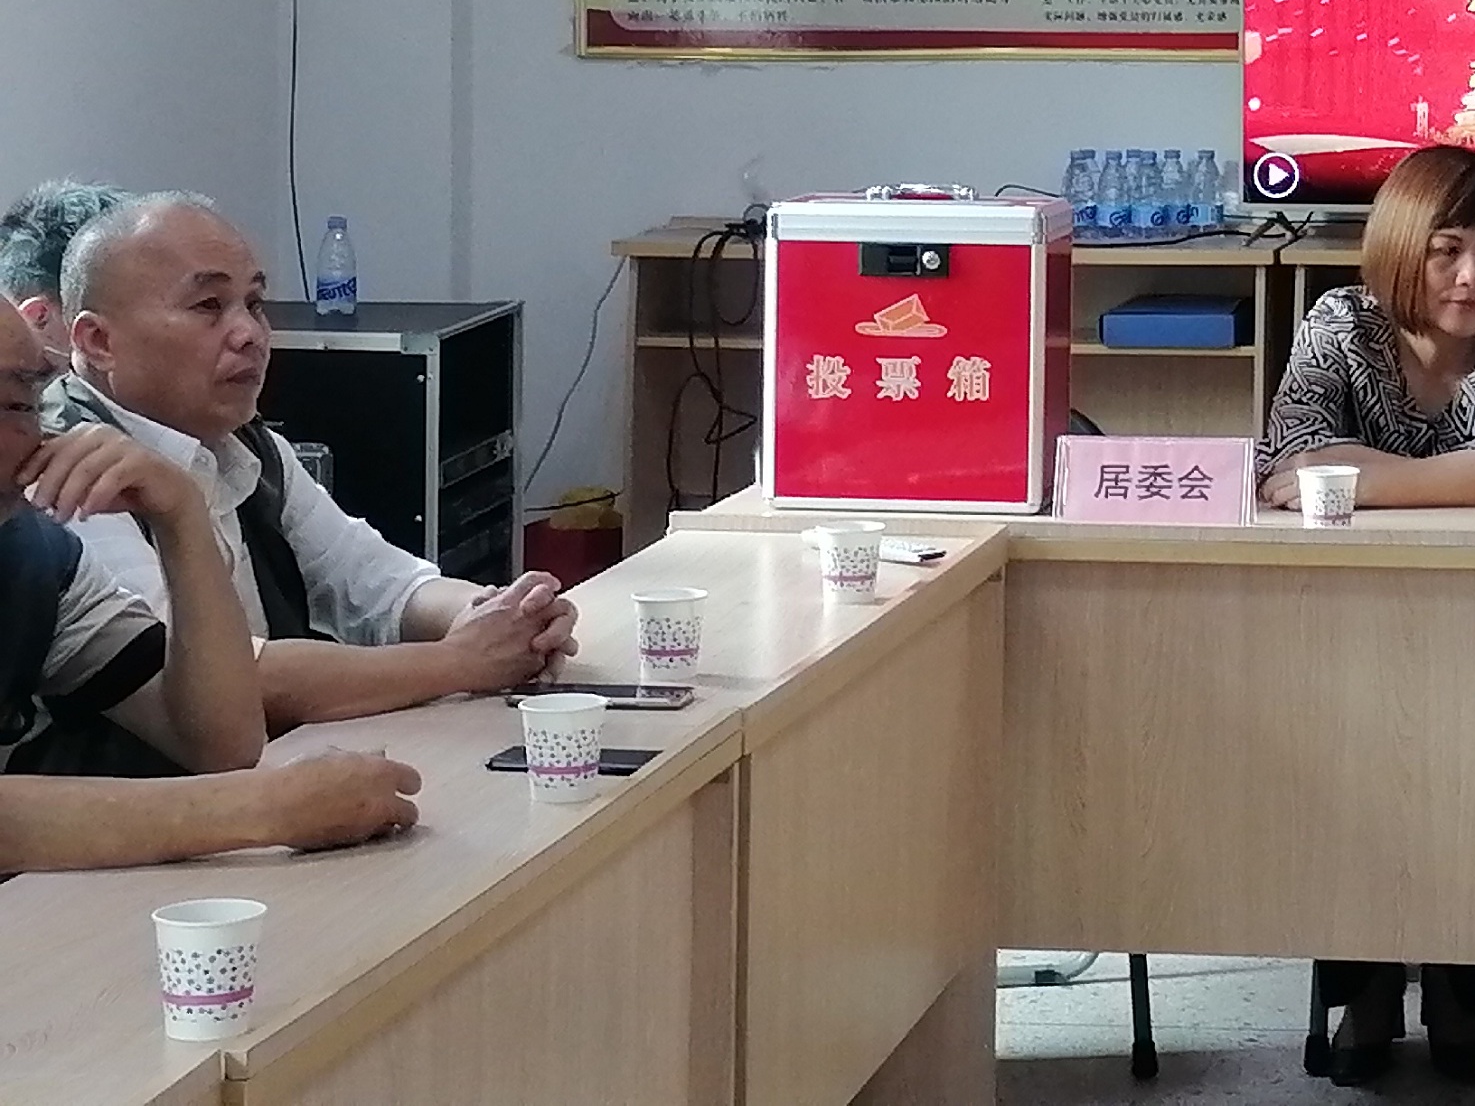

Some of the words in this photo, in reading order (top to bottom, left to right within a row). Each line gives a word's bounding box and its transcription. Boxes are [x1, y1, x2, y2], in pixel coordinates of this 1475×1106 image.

[805, 354, 994, 403] 投票箱
[1093, 463, 1216, 503] 居委会
